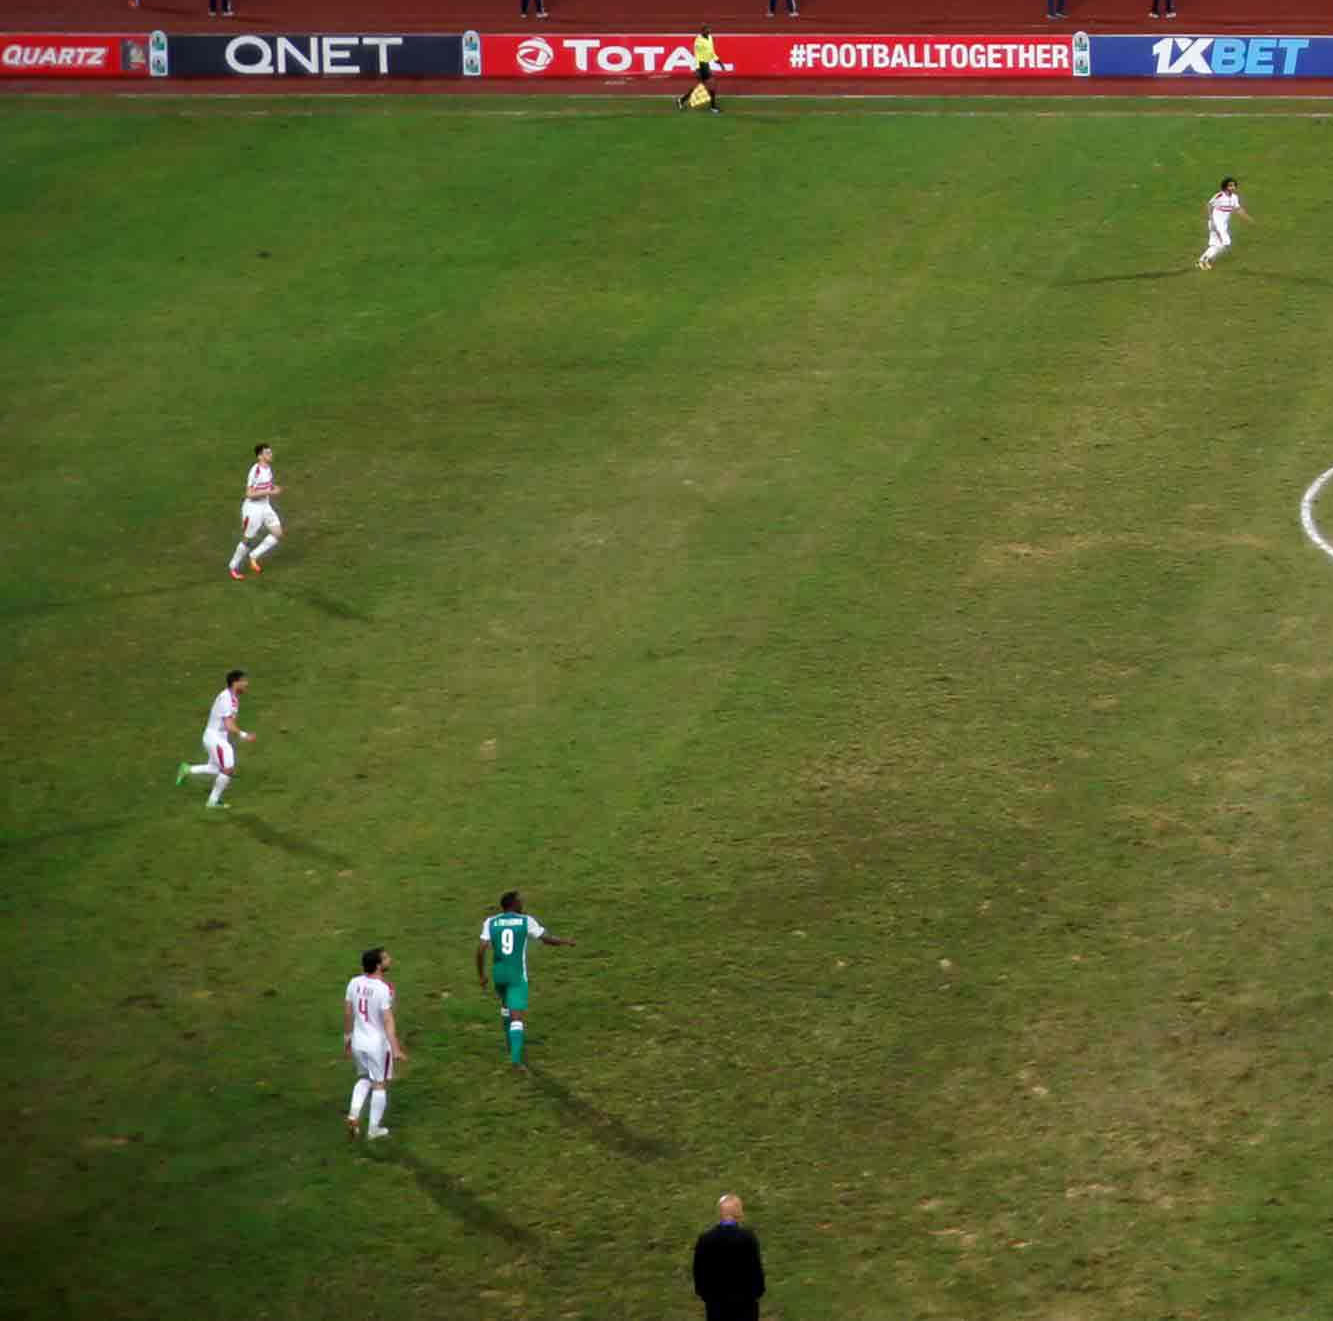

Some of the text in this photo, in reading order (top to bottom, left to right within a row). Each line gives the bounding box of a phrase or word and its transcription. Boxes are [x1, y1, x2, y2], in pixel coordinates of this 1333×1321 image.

[2, 44, 107, 68] QUARTZ
[225, 35, 403, 74] QNET
[789, 43, 1070, 70] #FOOTBALLTOGETHER
[1152, 38, 1309, 75] 1XBET
[501, 928, 514, 955] 9
[358, 997, 369, 1023] 4
